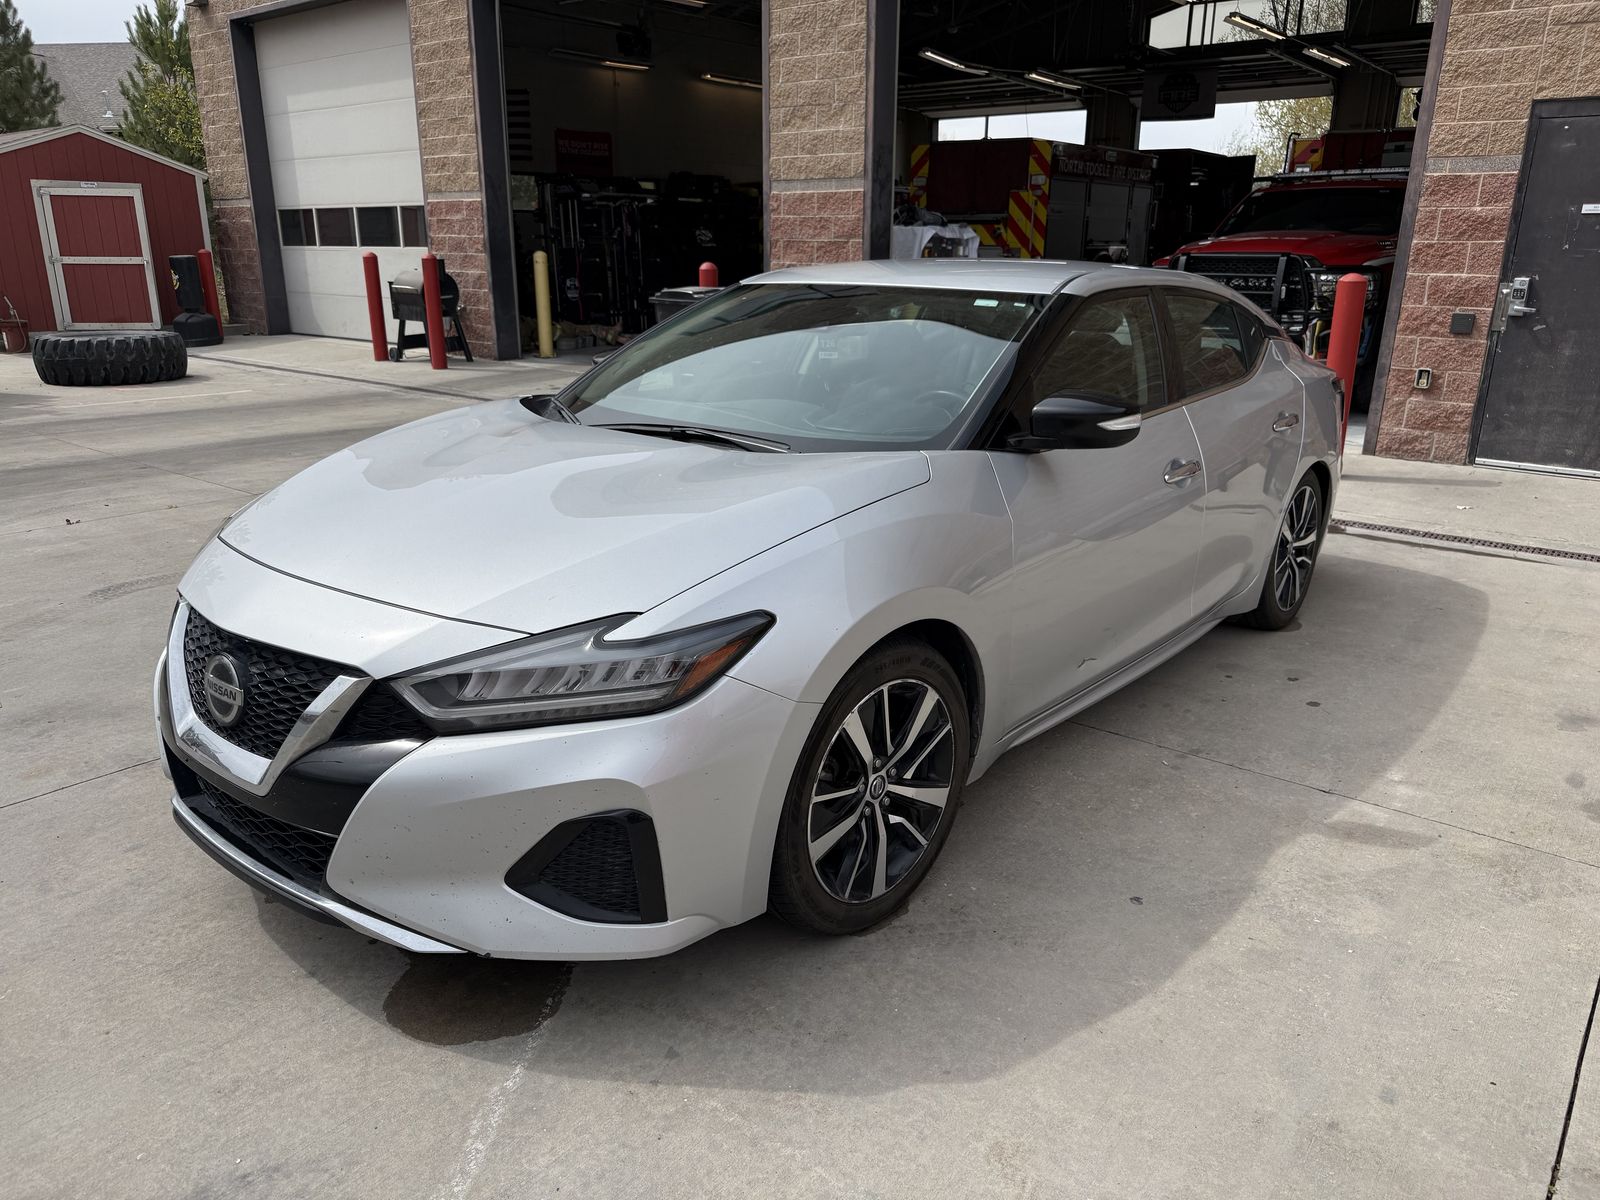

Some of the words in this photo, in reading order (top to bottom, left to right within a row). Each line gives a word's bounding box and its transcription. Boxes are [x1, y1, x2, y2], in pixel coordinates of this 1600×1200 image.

[1160, 89, 1197, 102] FIRE
[1058, 159, 1084, 174] NORTH
[1086, 162, 1110, 177] TOOELE
[1112, 165, 1126, 178] FIRE
[207, 678, 237, 702] NISSAN
